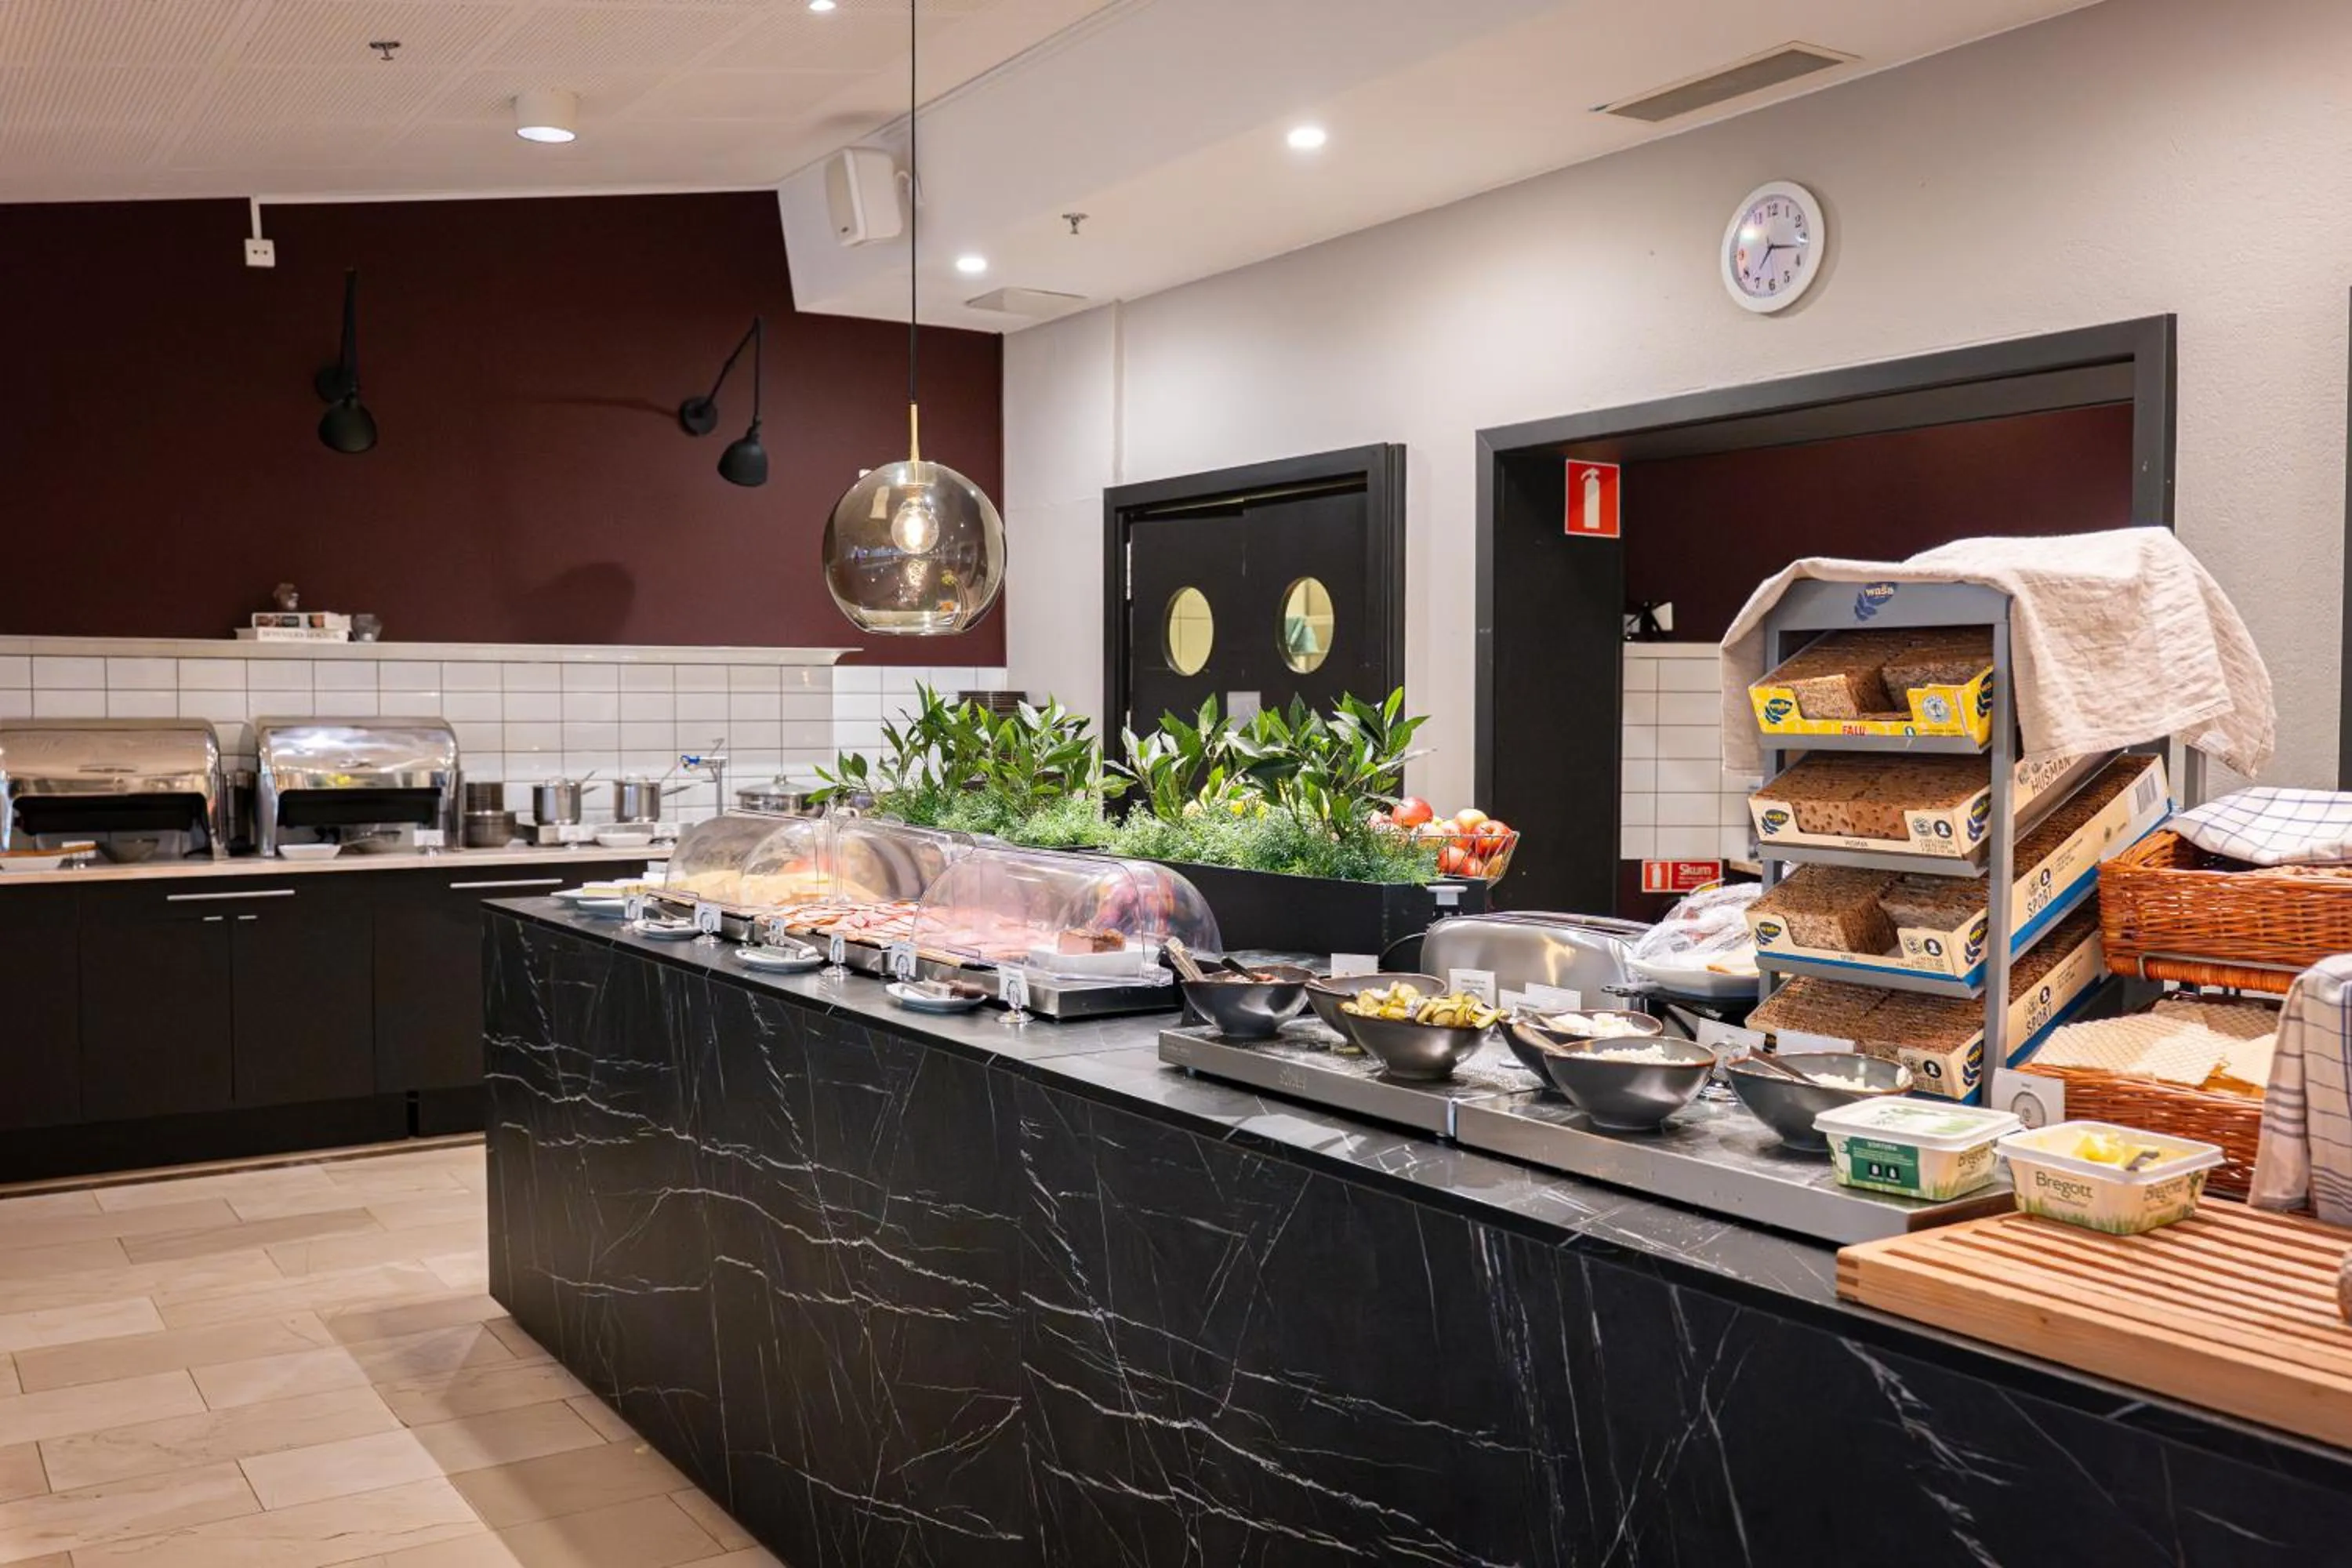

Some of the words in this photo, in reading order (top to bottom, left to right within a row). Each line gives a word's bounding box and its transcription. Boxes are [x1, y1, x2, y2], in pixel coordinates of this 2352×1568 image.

[1767, 203, 1778, 218] 12
[1769, 278, 1776, 290] 6
[1843, 725, 1866, 736] FALU
[2031, 755, 2071, 797] HUSMAN
[1679, 863, 1712, 876] Skum
[2027, 884, 2052, 918] SPORT
[2026, 1000, 2052, 1037] SPORT
[2035, 1171, 2093, 1200] Bregott
